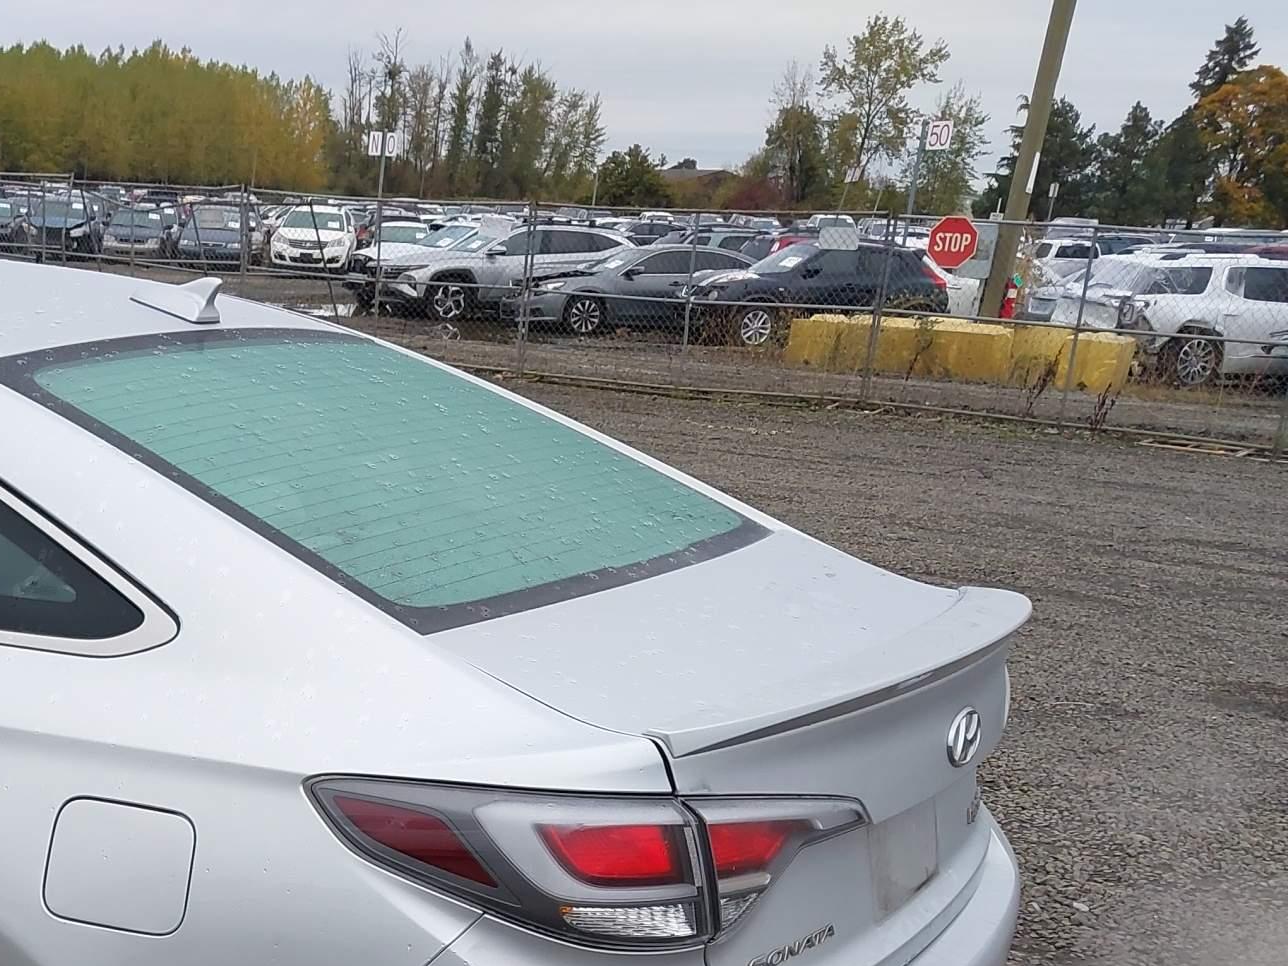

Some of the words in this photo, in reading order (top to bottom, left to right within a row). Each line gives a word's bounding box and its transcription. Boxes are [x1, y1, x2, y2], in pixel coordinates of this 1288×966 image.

[372, 133, 380, 153] N
[928, 124, 950, 147] 50
[933, 232, 972, 252] STOP
